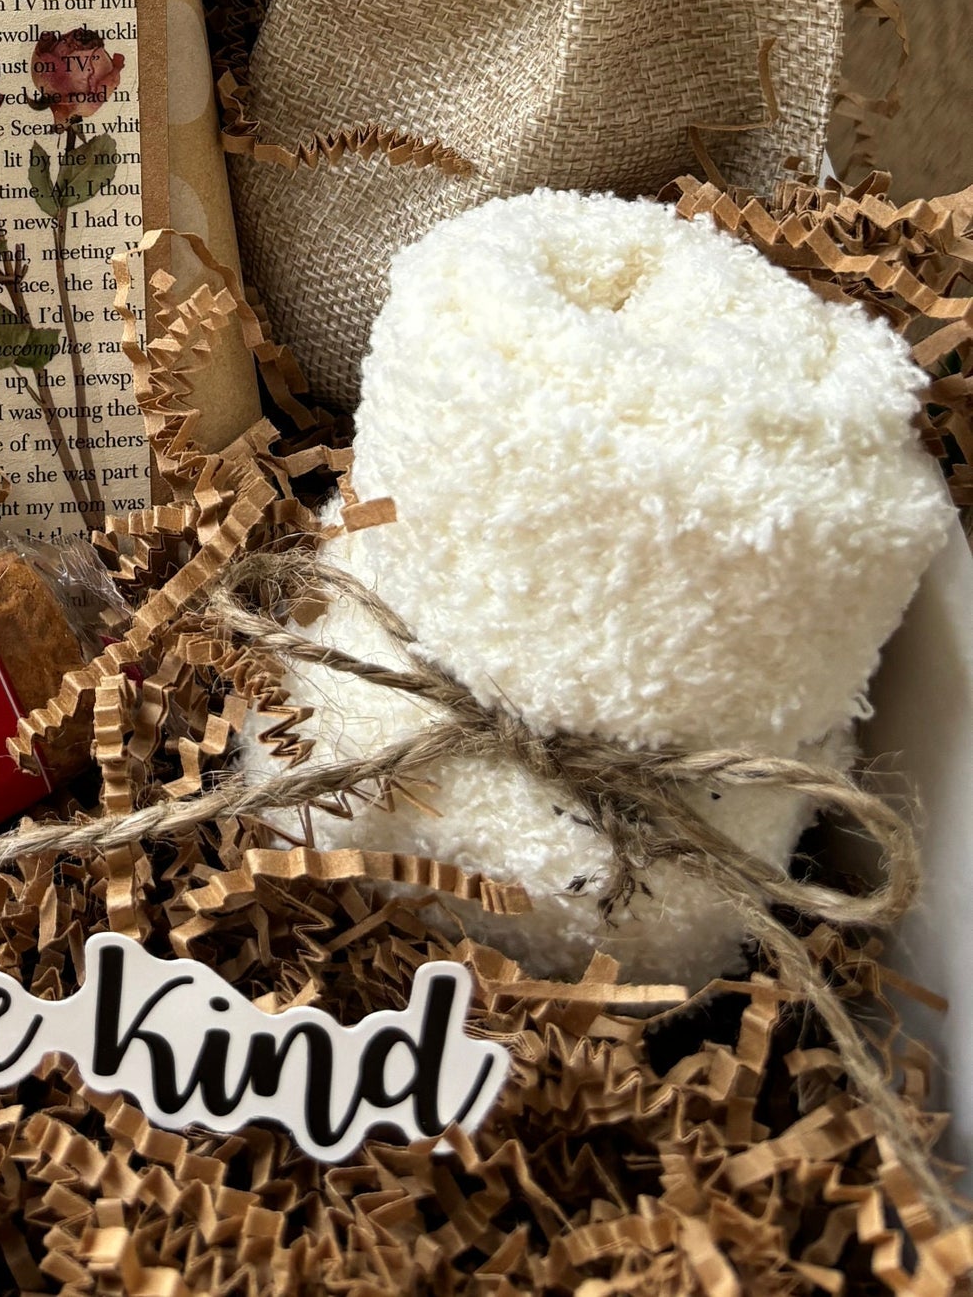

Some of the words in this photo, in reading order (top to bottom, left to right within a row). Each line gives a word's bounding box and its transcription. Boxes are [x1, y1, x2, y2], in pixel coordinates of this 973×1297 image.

[34, 61, 55, 73] on
[62, 55, 99, 73] TV.”
[34, 87, 61, 105] the
[68, 86, 107, 104] road
[114, 87, 130, 103] in
[79, 118, 95, 134] in
[4, 150, 22, 168] lit
[58, 148, 86, 166] the
[0, 183, 43, 200] time.
[86, 211, 117, 229] had
[124, 213, 142, 227] to
[42, 243, 115, 265] meeting
[13, 275, 55, 297] face,
[65, 274, 92, 292] the
[39, 306, 63, 324] I’d
[73, 305, 94, 323] be
[5, 376, 28, 394] up
[37, 369, 66, 387] the
[10, 408, 42, 420] was
[10, 434, 29, 452] of
[35, 438, 61, 456] my
[27, 465, 57, 483] she
[63, 468, 96, 481] was
[102, 464, 138, 484] part
[27, 502, 53, 519] my
[112, 498, 144, 511] was
